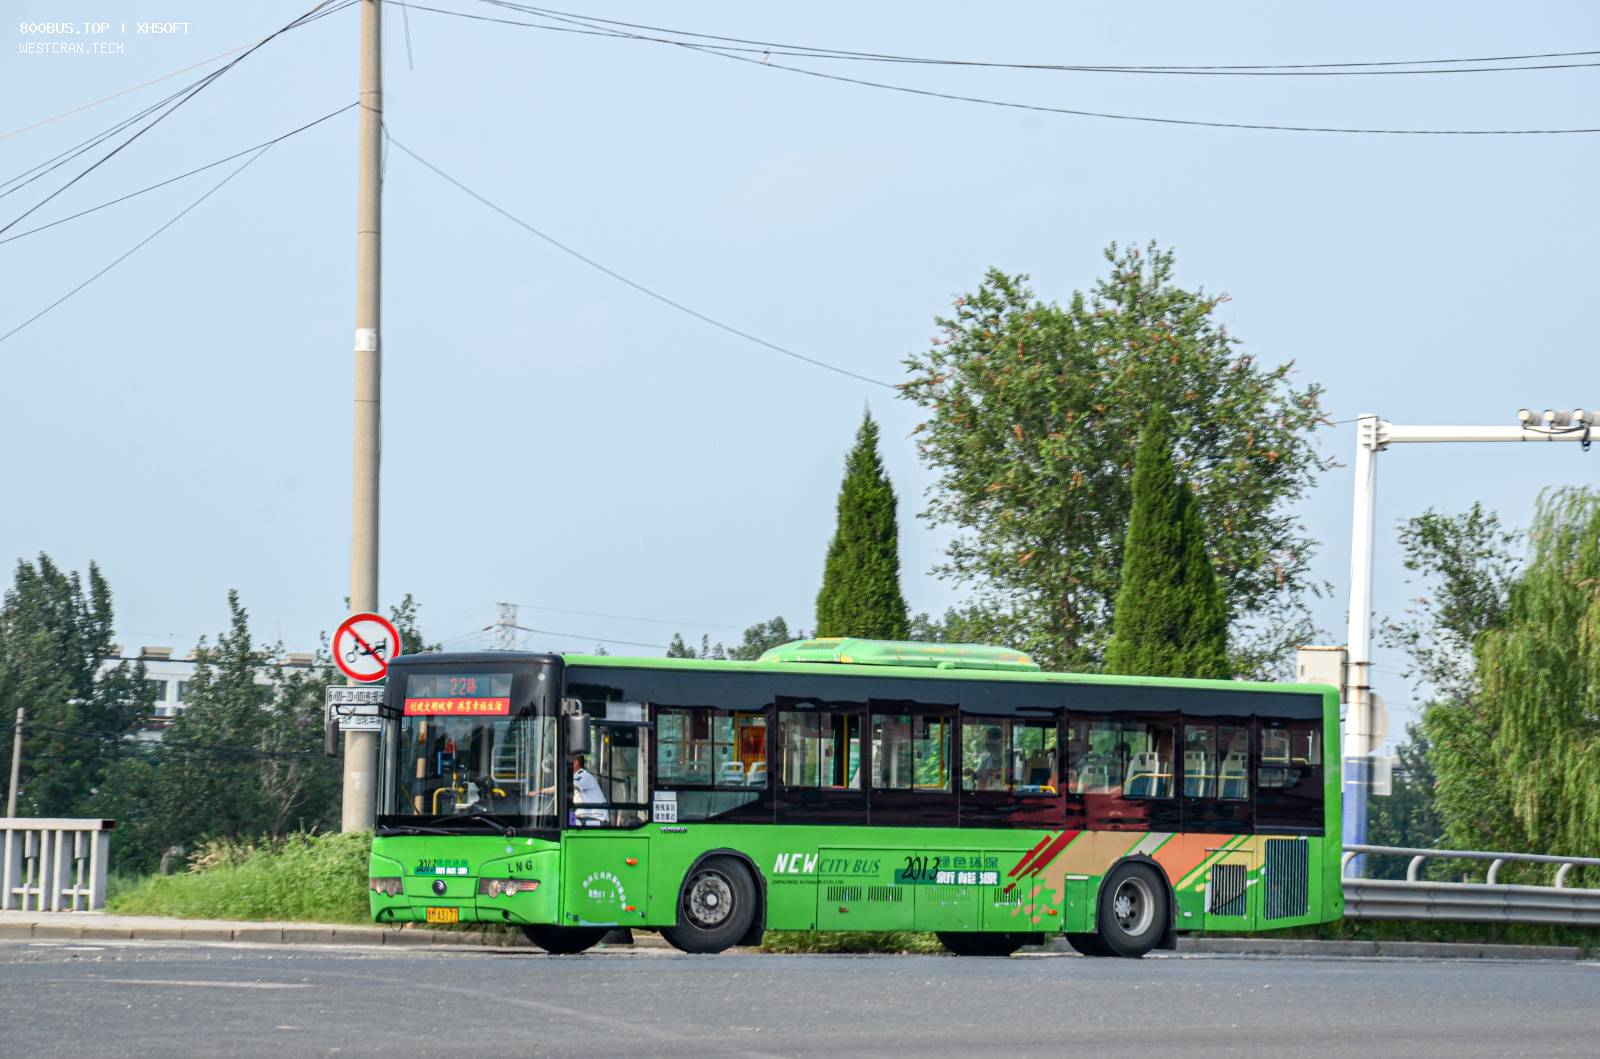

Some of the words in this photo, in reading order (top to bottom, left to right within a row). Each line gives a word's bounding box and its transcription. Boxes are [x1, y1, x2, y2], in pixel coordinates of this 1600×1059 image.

[449, 677, 477, 695] 22路
[508, 860, 533, 873] LNG
[773, 853, 819, 873] NEW
[820, 859, 850, 873] CITY
[853, 859, 881, 873] BUS
[902, 856, 940, 880] 2013
[936, 871, 997, 885] 新能源
